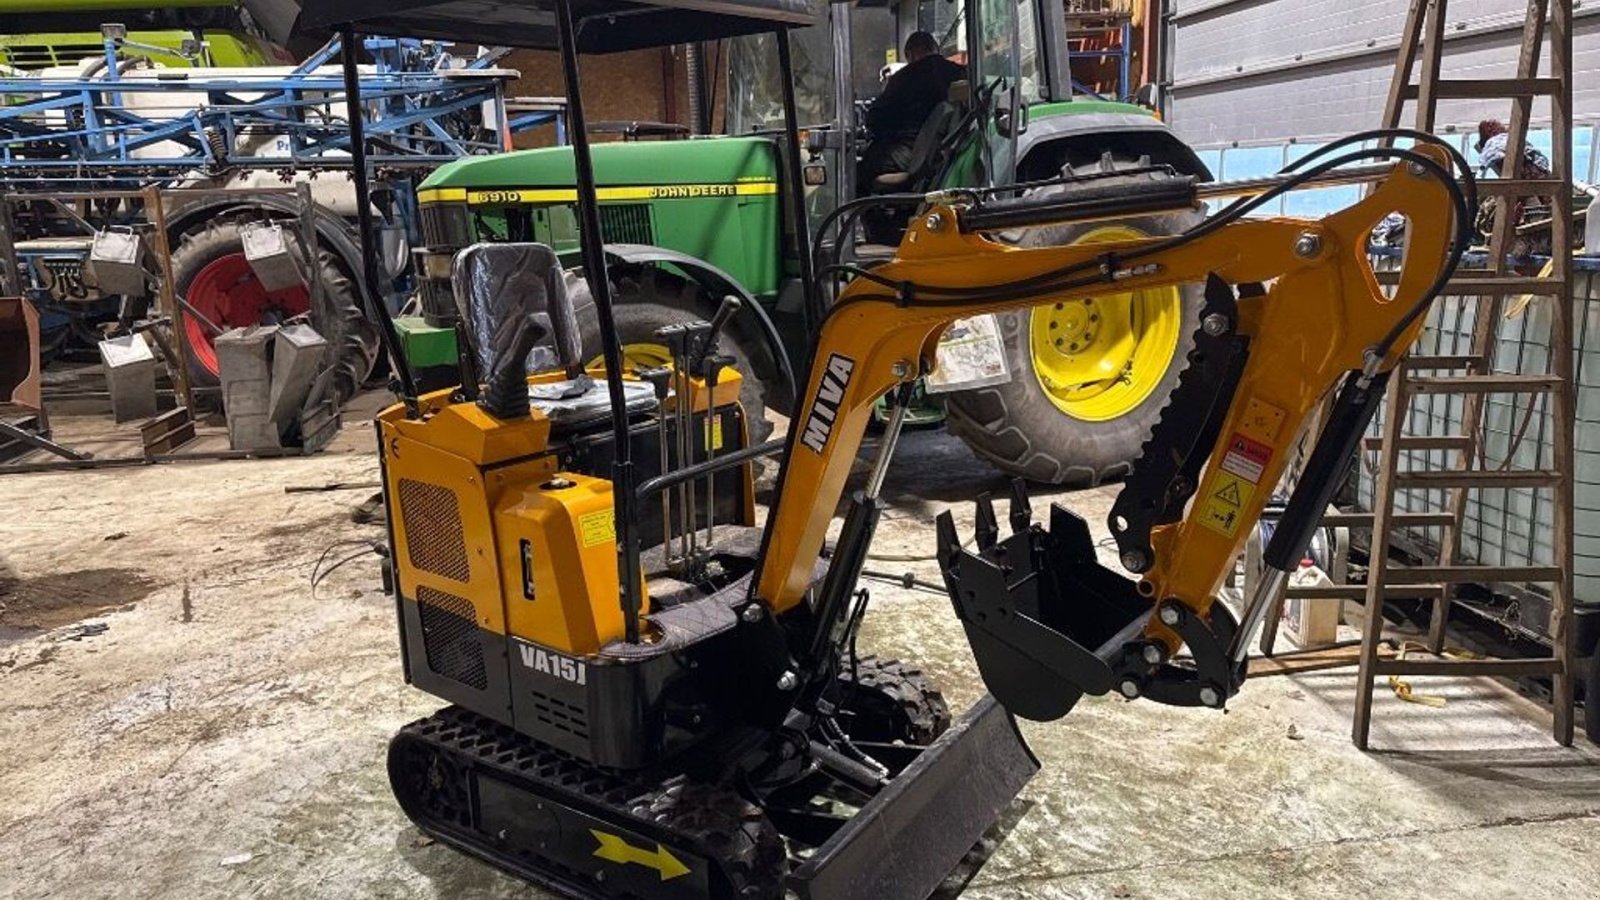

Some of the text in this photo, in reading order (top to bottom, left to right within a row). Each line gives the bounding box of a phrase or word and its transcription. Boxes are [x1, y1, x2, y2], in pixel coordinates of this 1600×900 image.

[648, 184, 735, 198] JOHN DEERE
[802, 354, 855, 452] MIVA
[518, 643, 587, 686] VA15J
